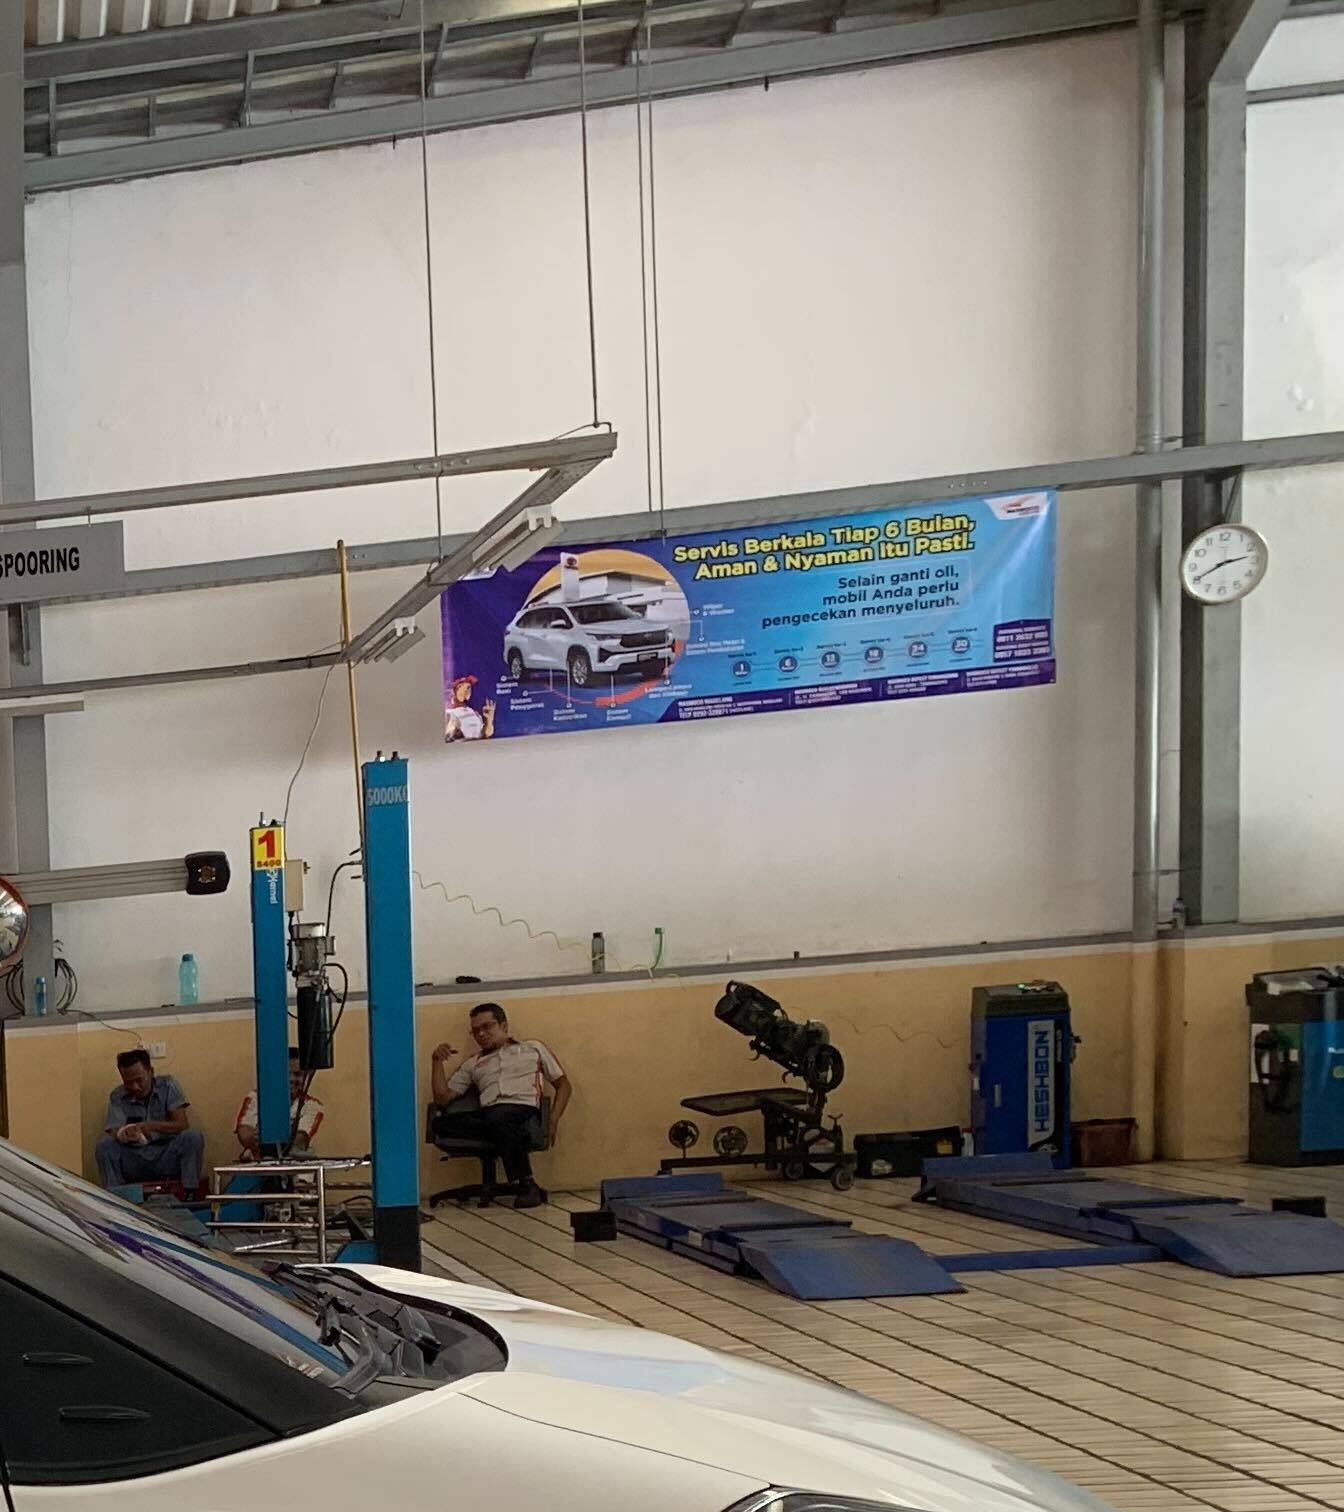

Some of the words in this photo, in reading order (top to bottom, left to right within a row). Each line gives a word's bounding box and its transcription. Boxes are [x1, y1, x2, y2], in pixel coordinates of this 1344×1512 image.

[674, 540, 738, 563] Servis
[744, 531, 826, 556] Berkala
[831, 526, 880, 546] Tiap
[884, 521, 900, 538] 6
[905, 513, 977, 536] Bulan,
[1219, 531, 1232, 541] 12
[694, 559, 758, 581] Aman
[762, 556, 780, 574] &
[785, 546, 874, 572] Nyaman
[879, 540, 909, 560] Itu
[914, 533, 975, 557] Pasti.
[822, 588, 868, 606] mobil
[872, 585, 913, 601] Anda
[917, 579, 960, 600] perlu
[838, 573, 886, 590] Selain
[890, 567, 930, 587] ganti
[935, 565, 960, 583] oli,
[761, 608, 857, 630] pengecekan
[861, 597, 961, 619] menyeluruh.
[257, 829, 276, 859] 1
[1034, 1028, 1050, 1133] HESHBON
